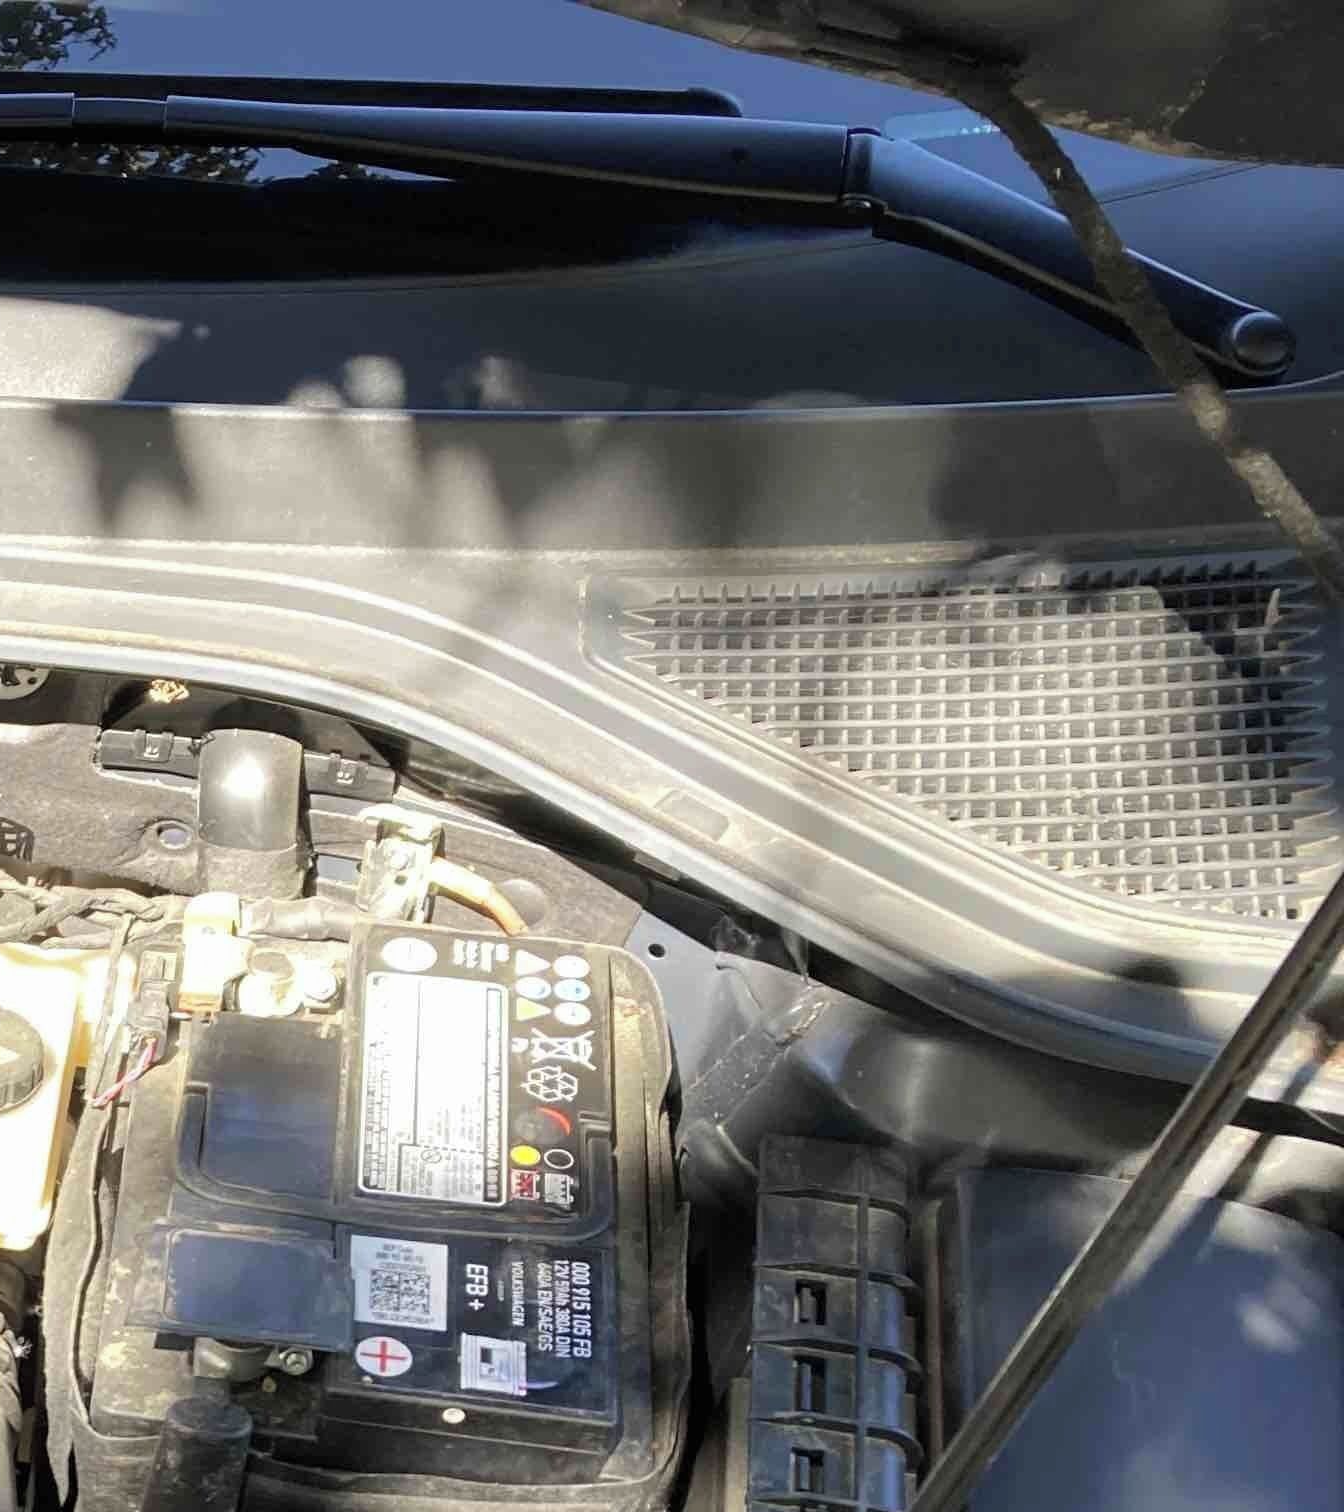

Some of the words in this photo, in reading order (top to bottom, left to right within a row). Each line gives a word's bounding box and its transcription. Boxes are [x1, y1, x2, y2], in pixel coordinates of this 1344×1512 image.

[465, 1263, 489, 1297] EFB
[553, 1260, 570, 1280] 12V
[571, 1261, 591, 1286] 000
[511, 1261, 525, 1327] VOLKSWAGEN
[572, 1287, 592, 1311] 915
[536, 1290, 553, 1352] EN/SAE/GS
[554, 1307, 571, 1334] 380A
[572, 1313, 592, 1337] 105
[554, 1336, 571, 1358] DIN
[572, 1338, 592, 1359] FB
